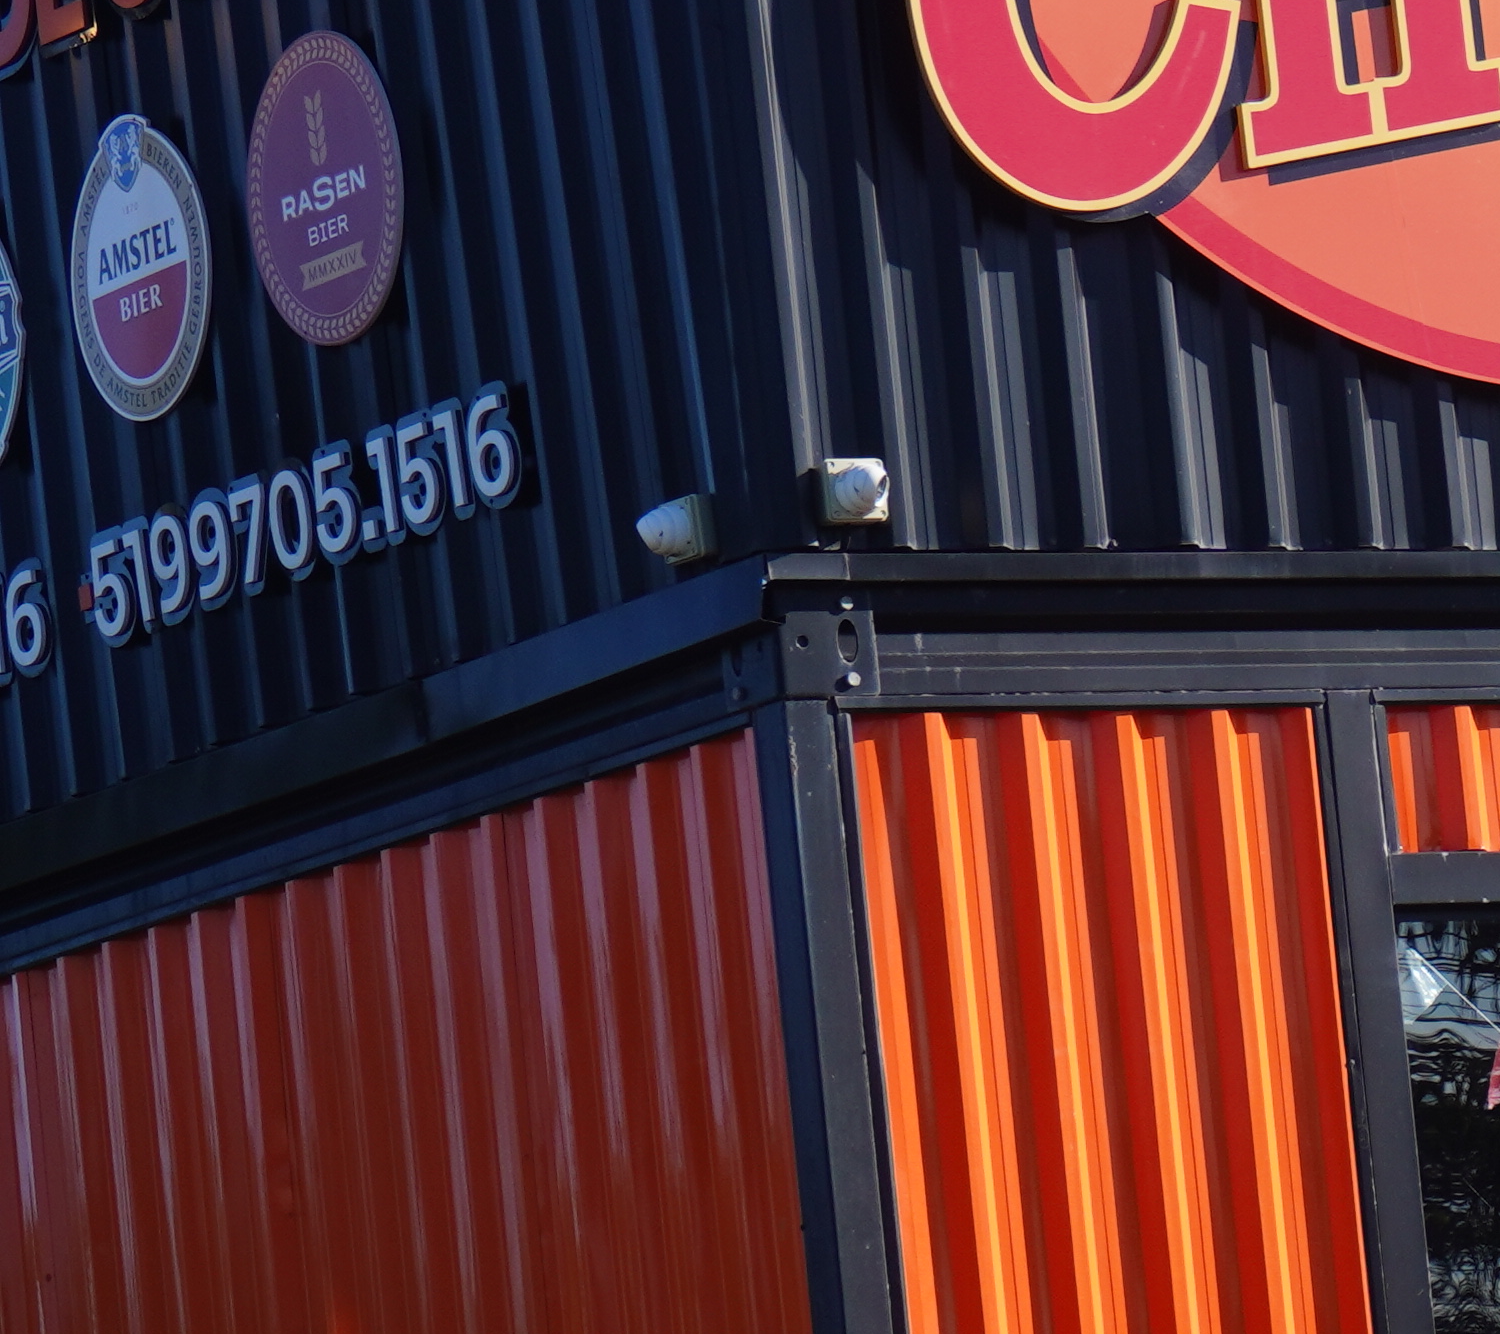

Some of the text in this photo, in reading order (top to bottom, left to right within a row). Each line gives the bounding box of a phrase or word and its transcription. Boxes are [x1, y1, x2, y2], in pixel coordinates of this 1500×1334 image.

[307, 214, 349, 248] BIER
[98, 218, 178, 287] AMSTEL
[307, 250, 359, 284] MMXXIV
[119, 283, 164, 323] BIER
